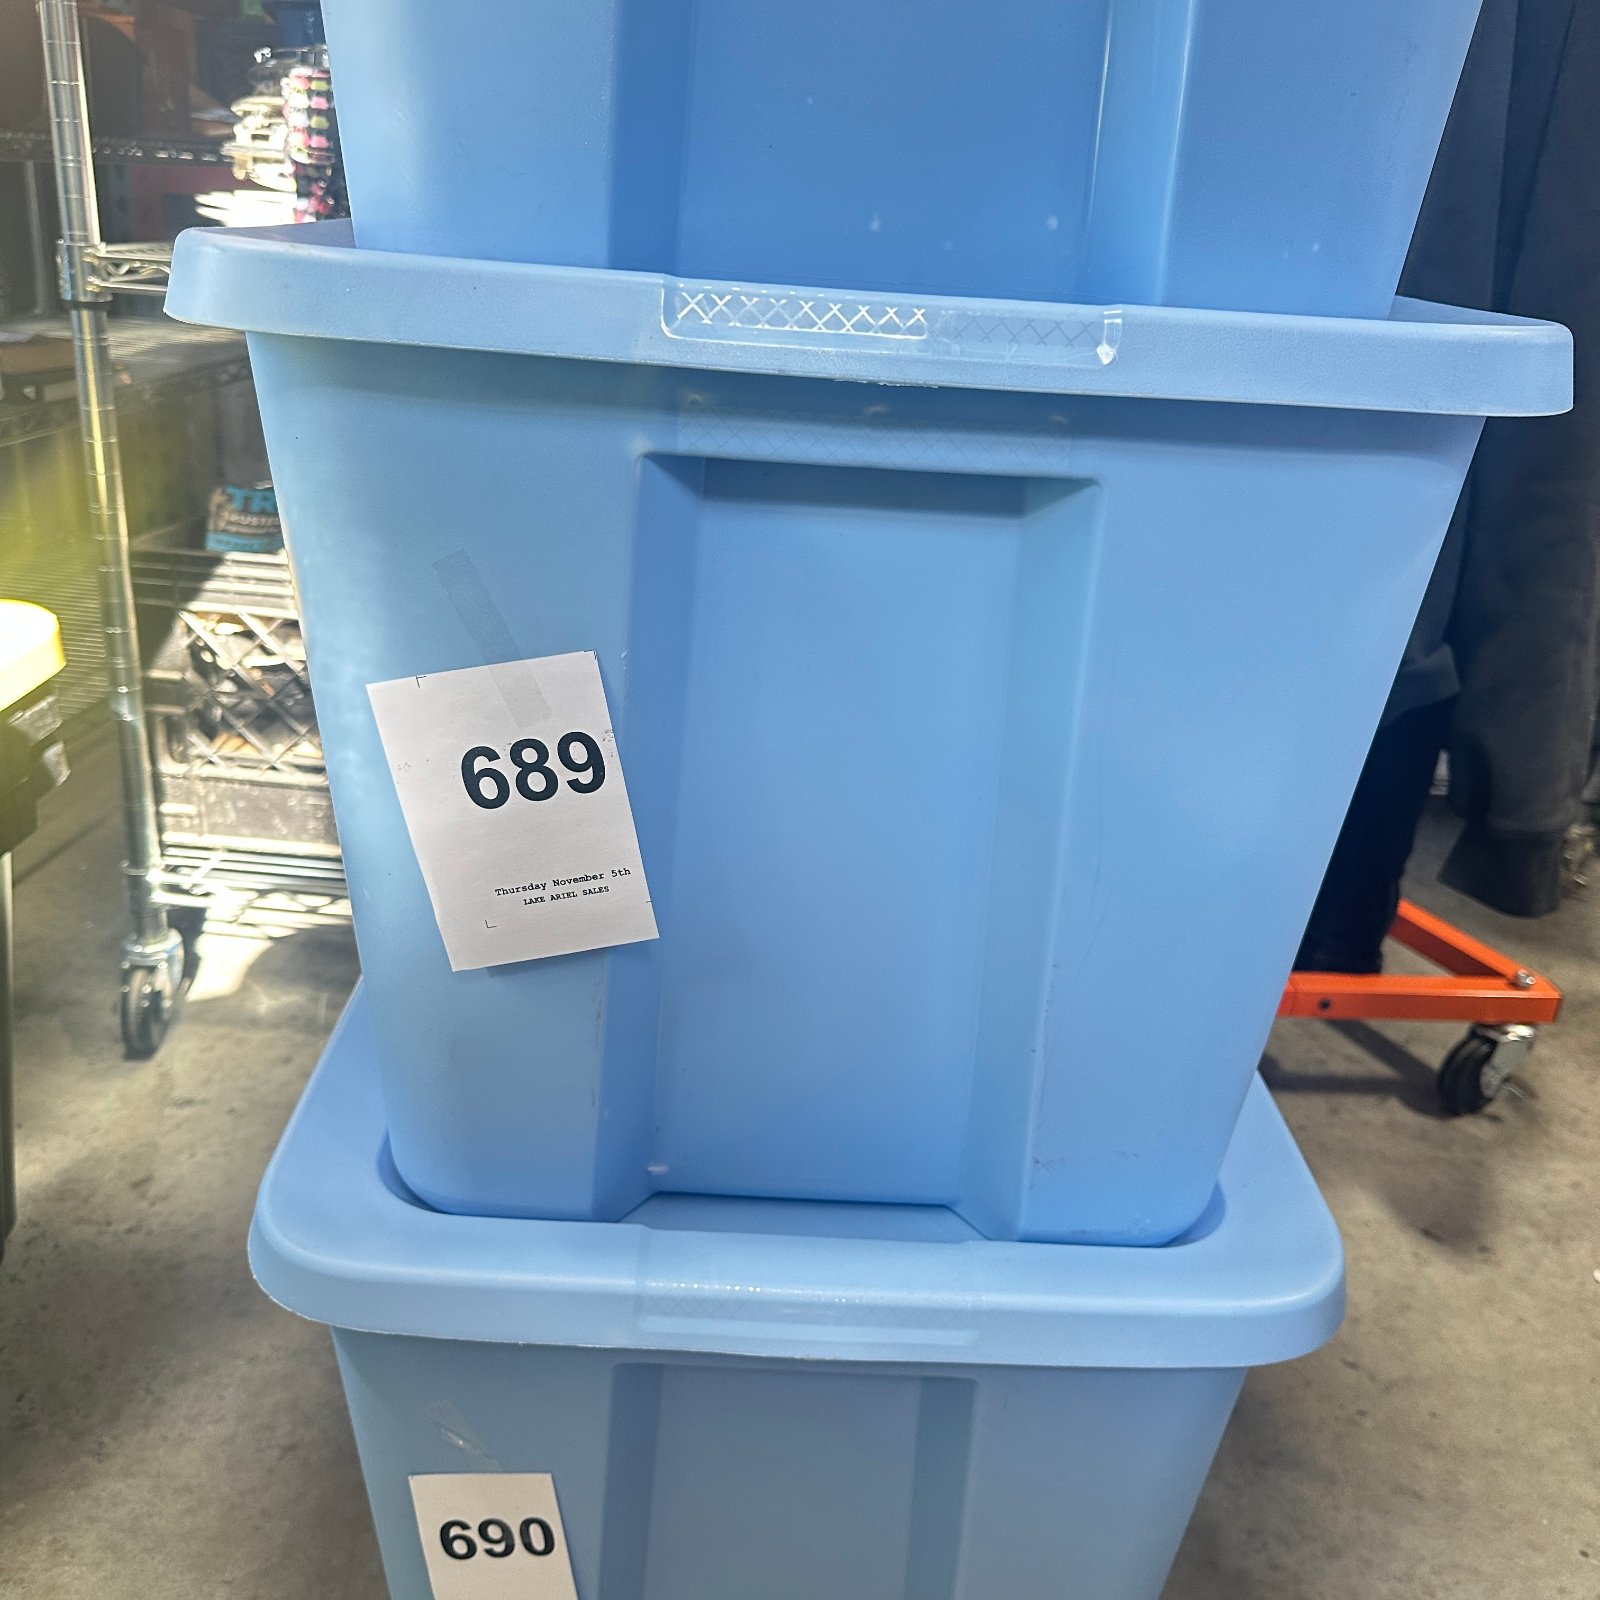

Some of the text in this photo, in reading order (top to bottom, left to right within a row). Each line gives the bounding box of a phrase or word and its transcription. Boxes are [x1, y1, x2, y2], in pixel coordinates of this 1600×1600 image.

[461, 731, 606, 810] 689
[494, 867, 632, 897] Thursday November 5th
[523, 885, 610, 906] LAKE ARIEL SALES
[439, 1517, 555, 1561] 690
